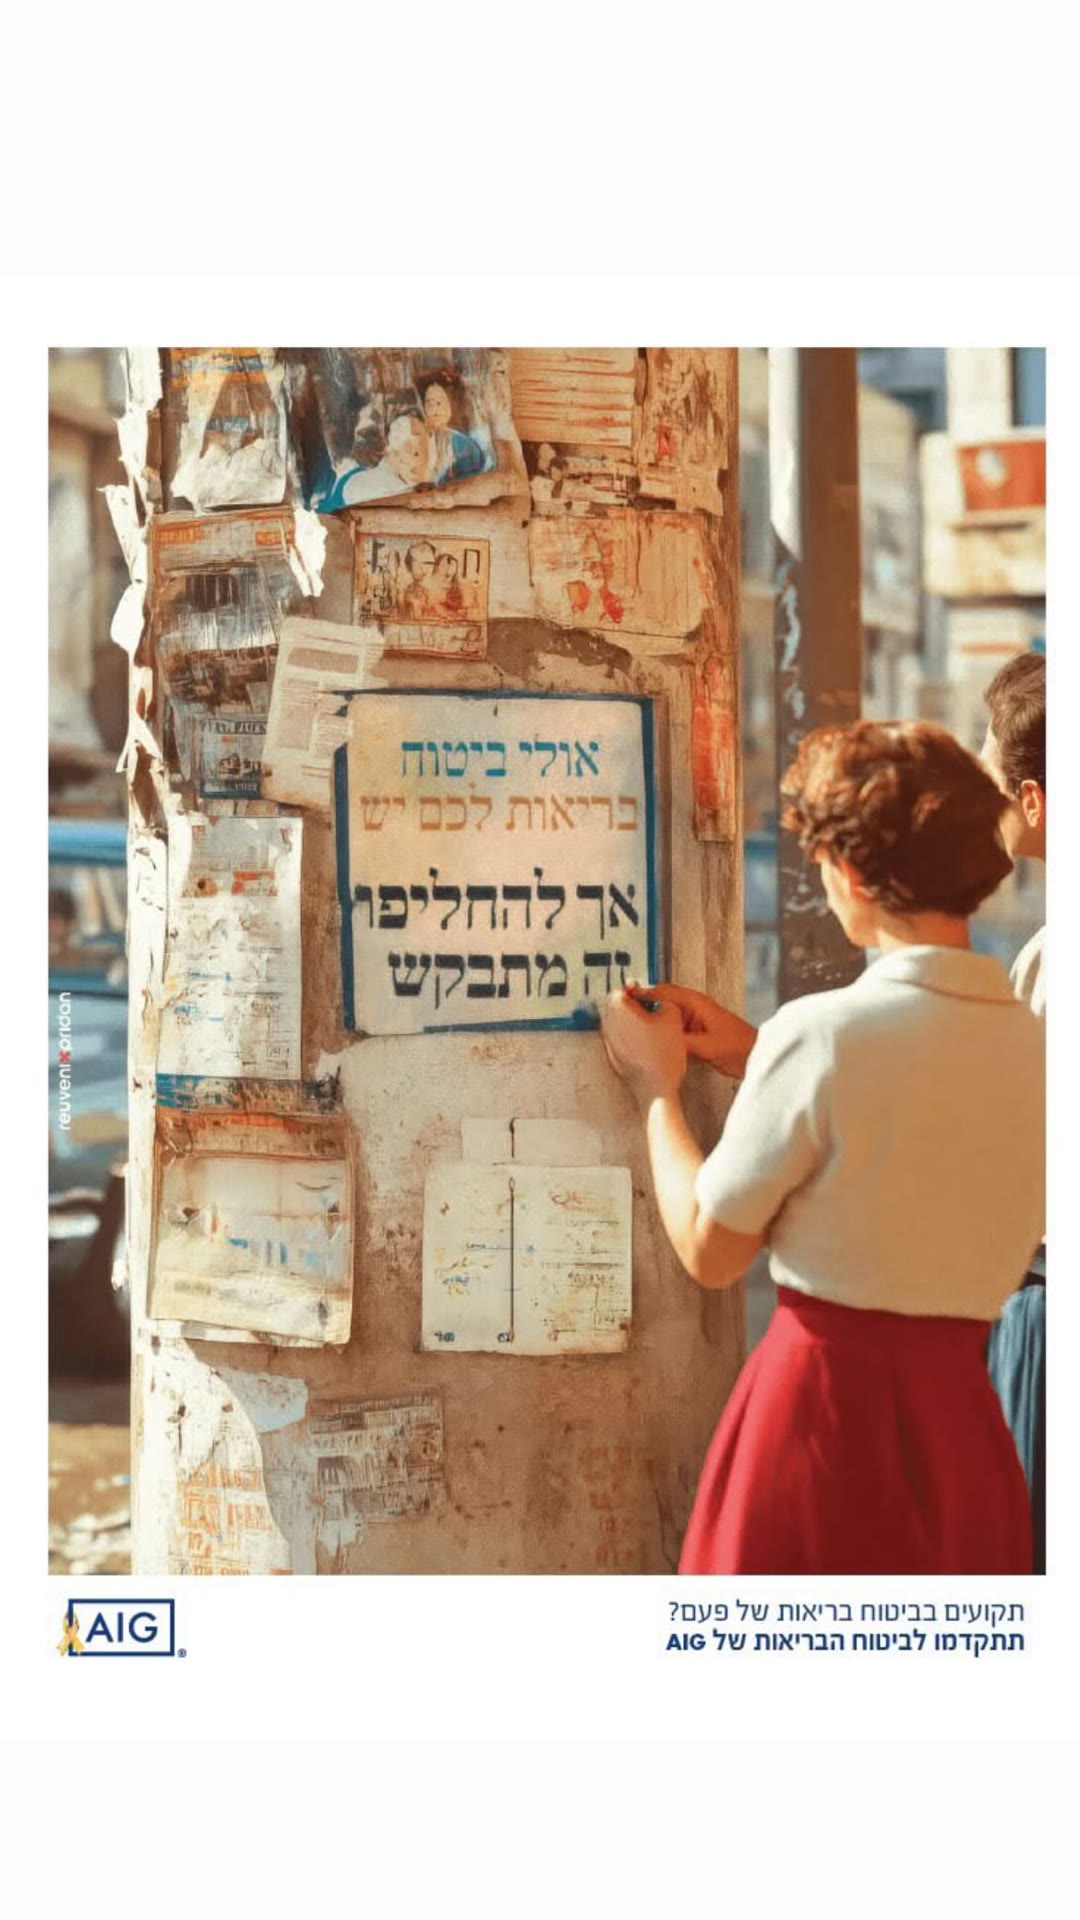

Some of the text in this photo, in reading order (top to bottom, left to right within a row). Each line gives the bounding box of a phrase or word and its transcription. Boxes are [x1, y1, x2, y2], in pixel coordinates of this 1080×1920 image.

[402, 734, 599, 777] אולי ביטוח
[360, 783, 638, 831] בריאות לכם יש
[354, 867, 639, 941] אך להחליפו
[388, 951, 632, 1010] זה מתבקש
